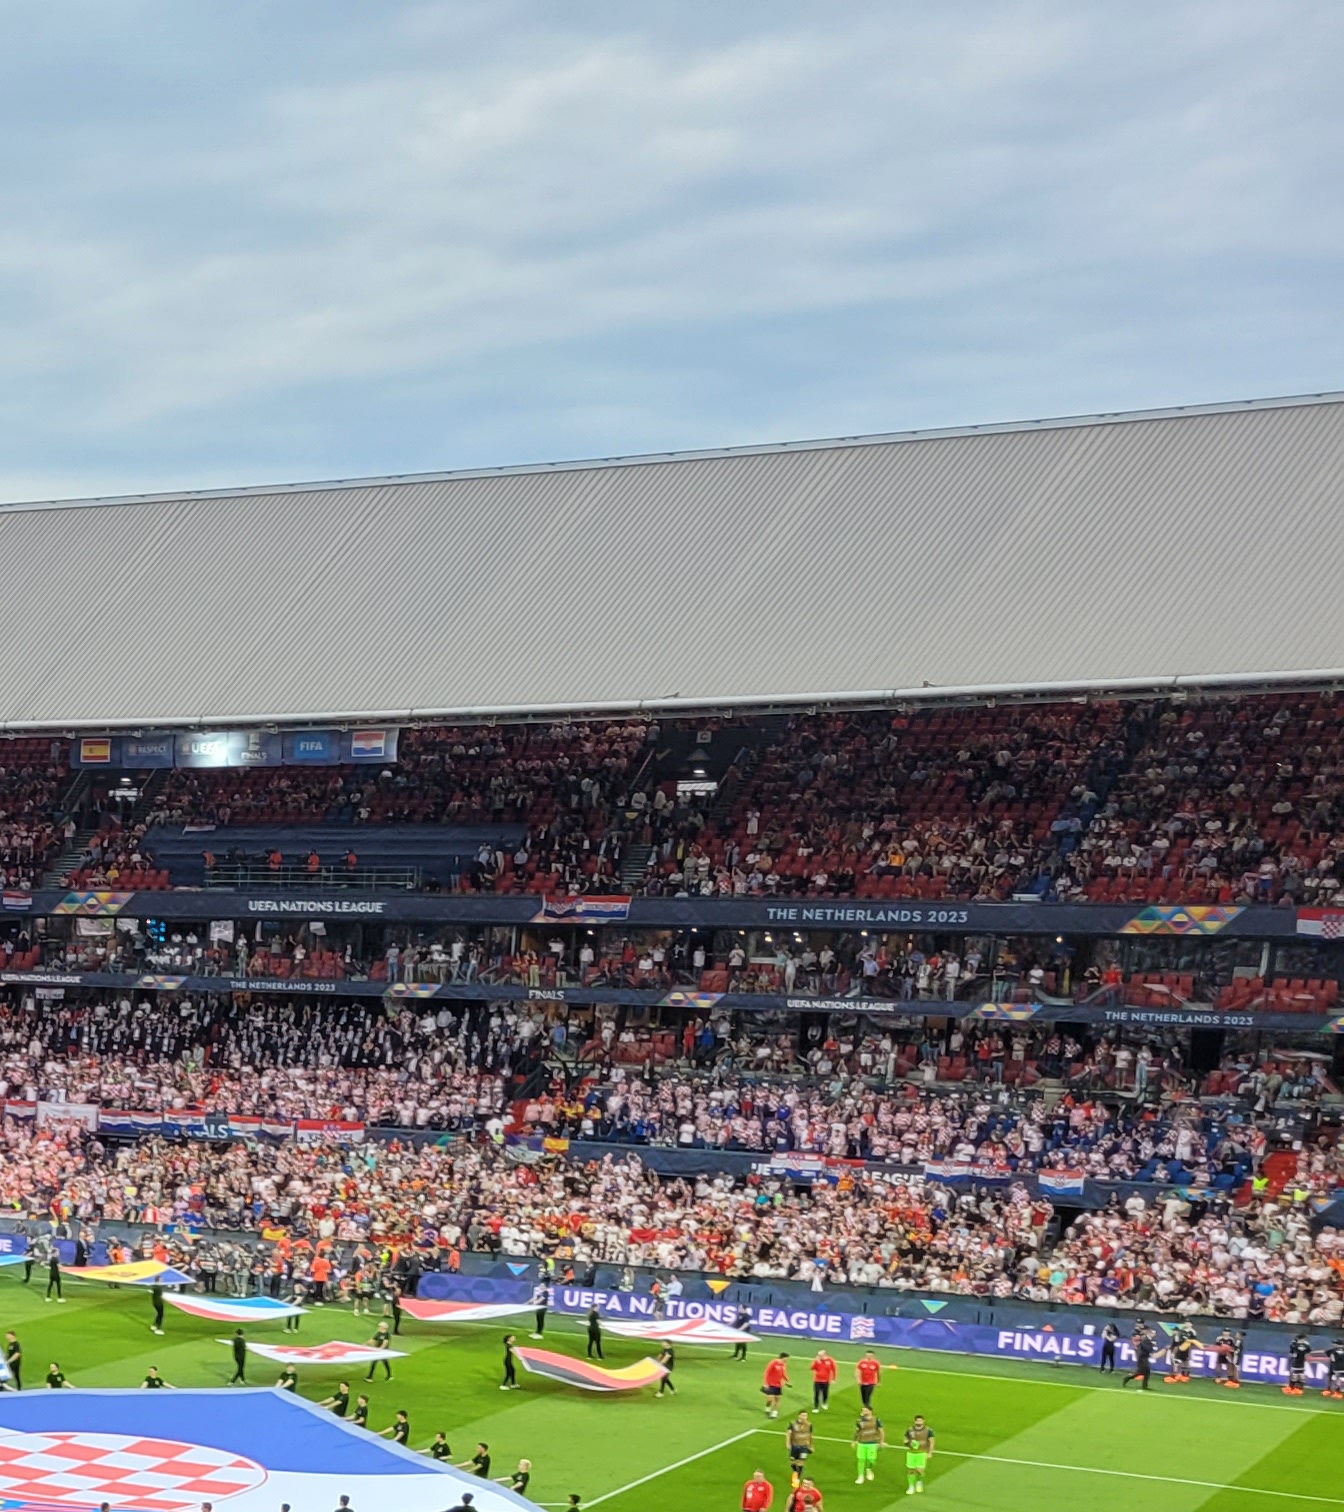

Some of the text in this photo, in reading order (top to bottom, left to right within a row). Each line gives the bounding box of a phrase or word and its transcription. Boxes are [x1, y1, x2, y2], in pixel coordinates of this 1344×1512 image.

[300, 741, 323, 752] FIFA
[248, 900, 383, 913] UEFA NATIONS LEAGUE
[767, 908, 968, 923] THE NETHERLANDS 2023
[229, 980, 336, 992] THE NETHERLANDS 2023
[528, 989, 565, 1001] FINALS
[812, 1000, 855, 1010] NATIONS
[855, 1001, 895, 1012] LEAGUE
[1105, 1011, 1254, 1026] THE NETHERLANDS 2023
[563, 1289, 843, 1333] UEFA NATIONS LEAGUE
[997, 1331, 1095, 1358] FINALS
